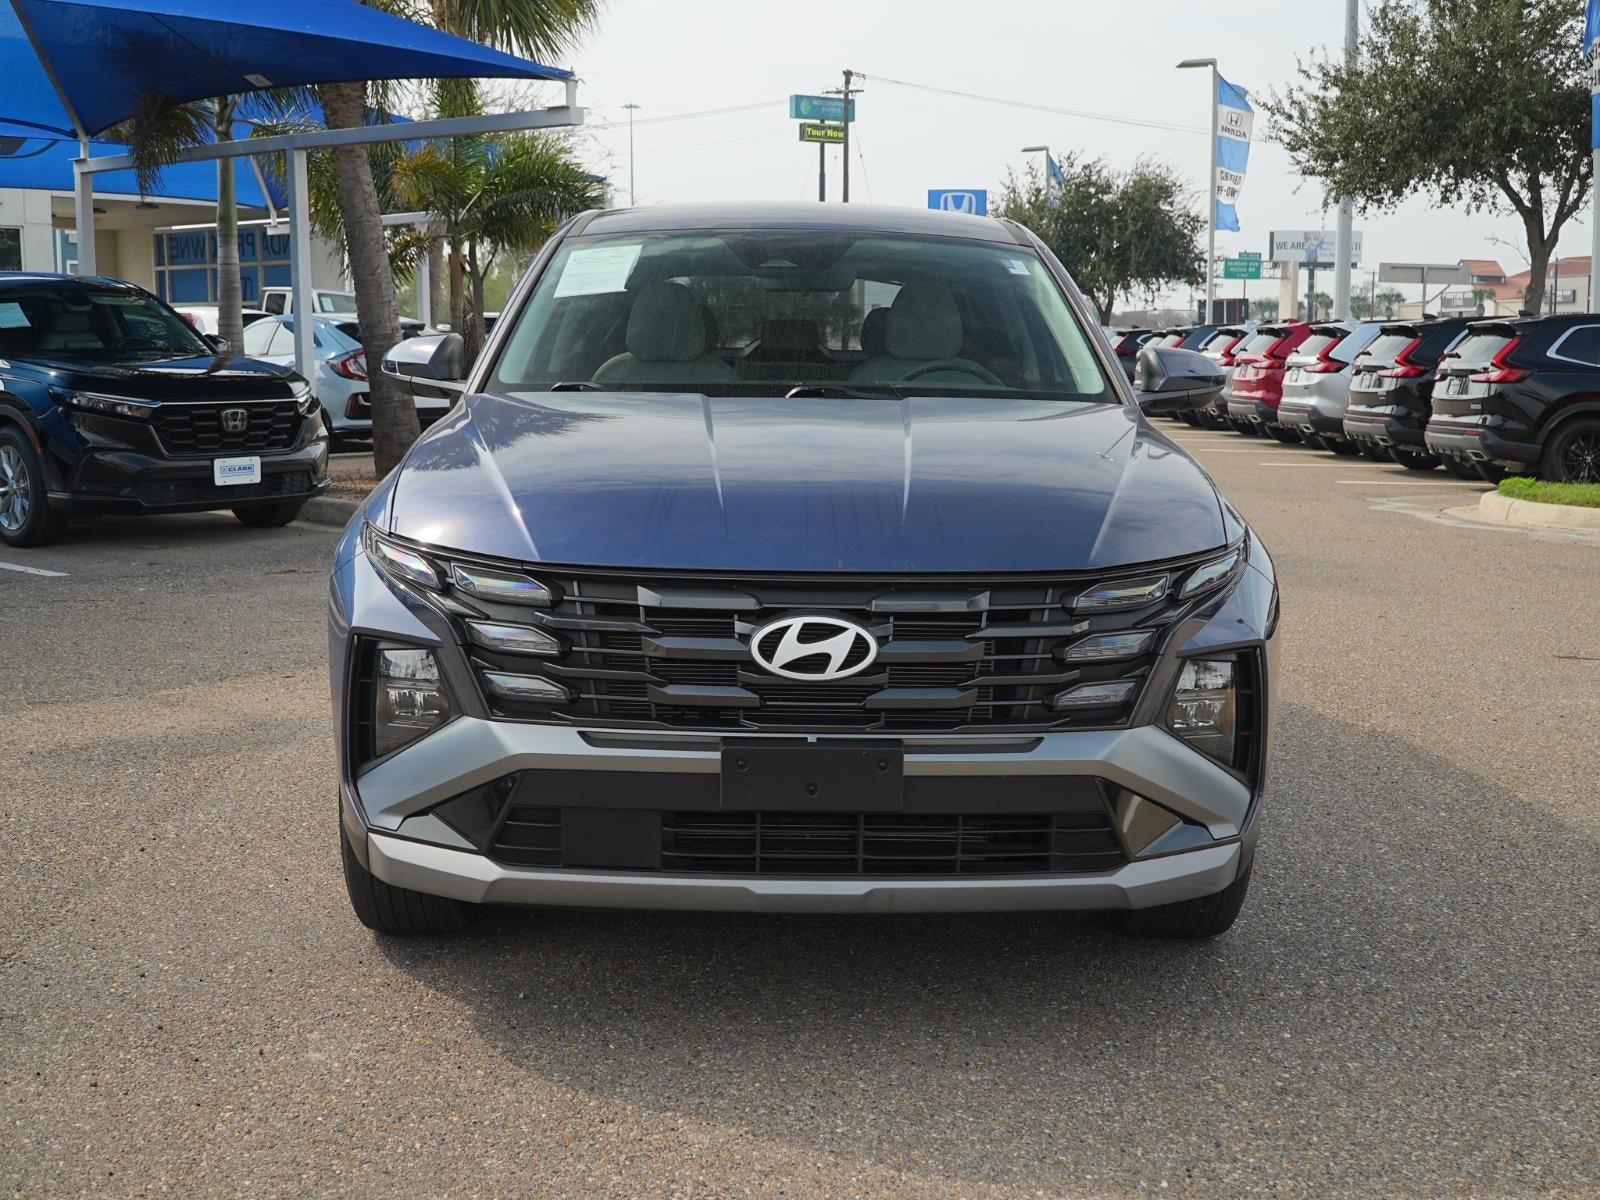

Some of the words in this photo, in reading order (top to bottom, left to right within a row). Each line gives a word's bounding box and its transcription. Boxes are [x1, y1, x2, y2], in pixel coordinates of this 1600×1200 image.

[806, 128, 825, 137] Tour
[828, 129, 844, 138] Now
[1221, 125, 1247, 138] HONDA
[1276, 241, 1288, 250] WE
[1290, 241, 1306, 250] ARE
